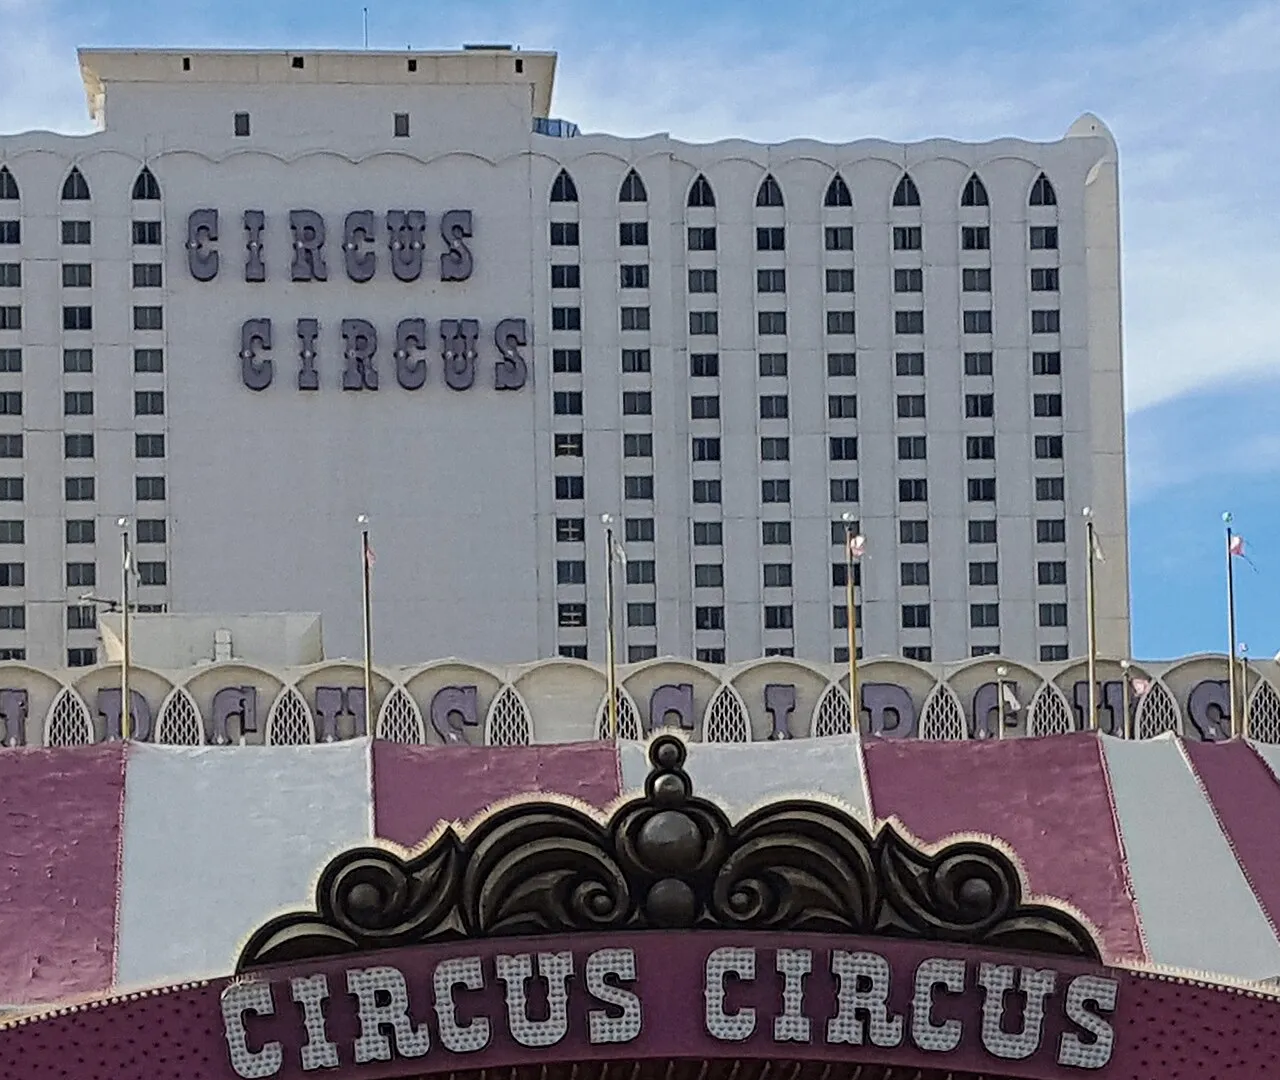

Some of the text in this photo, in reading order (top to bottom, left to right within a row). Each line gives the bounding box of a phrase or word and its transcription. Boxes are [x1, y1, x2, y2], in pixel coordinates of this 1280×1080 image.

[185, 208, 474, 283] CIRCUS
[239, 317, 528, 391] CIRCUS
[220, 945, 1120, 1080] CIRCUS CIRCUS
